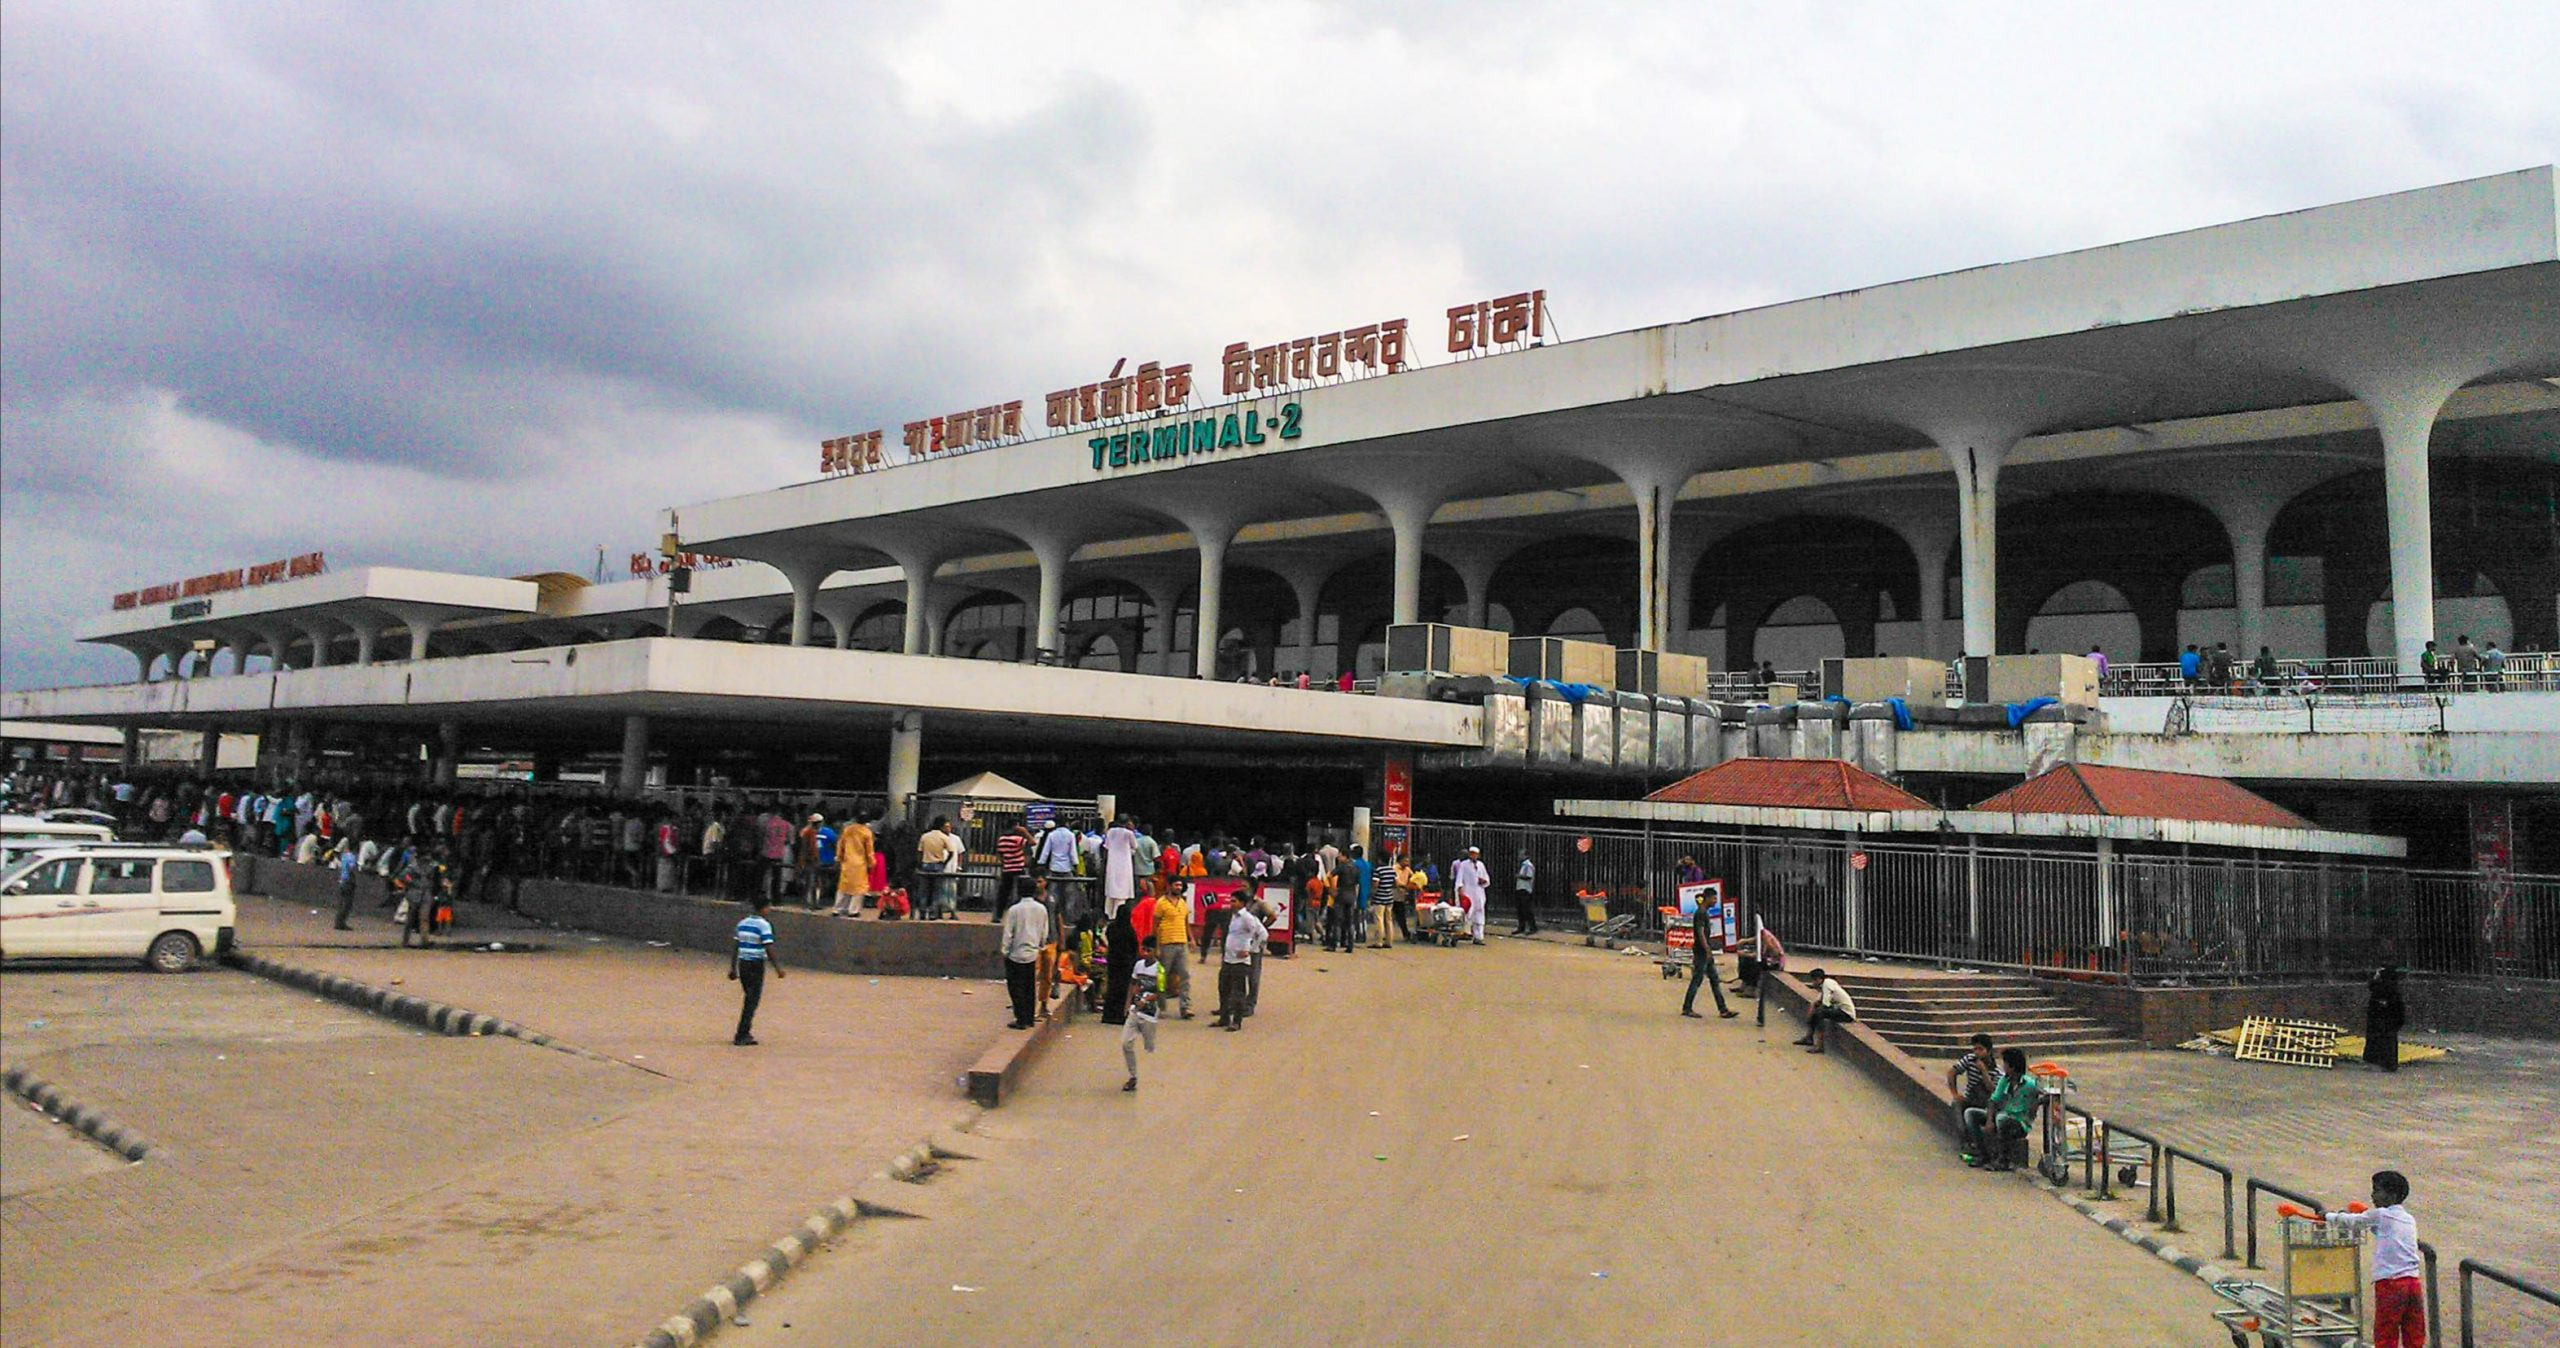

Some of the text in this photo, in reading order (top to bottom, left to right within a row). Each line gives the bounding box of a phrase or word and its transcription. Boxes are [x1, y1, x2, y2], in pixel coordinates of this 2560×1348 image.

[1045, 357, 1193, 427] আন্তর্জাতিক
[1222, 317, 1409, 396] বিমানবন্দর
[1446, 289, 1547, 354] ঢাকা
[1088, 402, 1303, 470] TERMINAL-2
